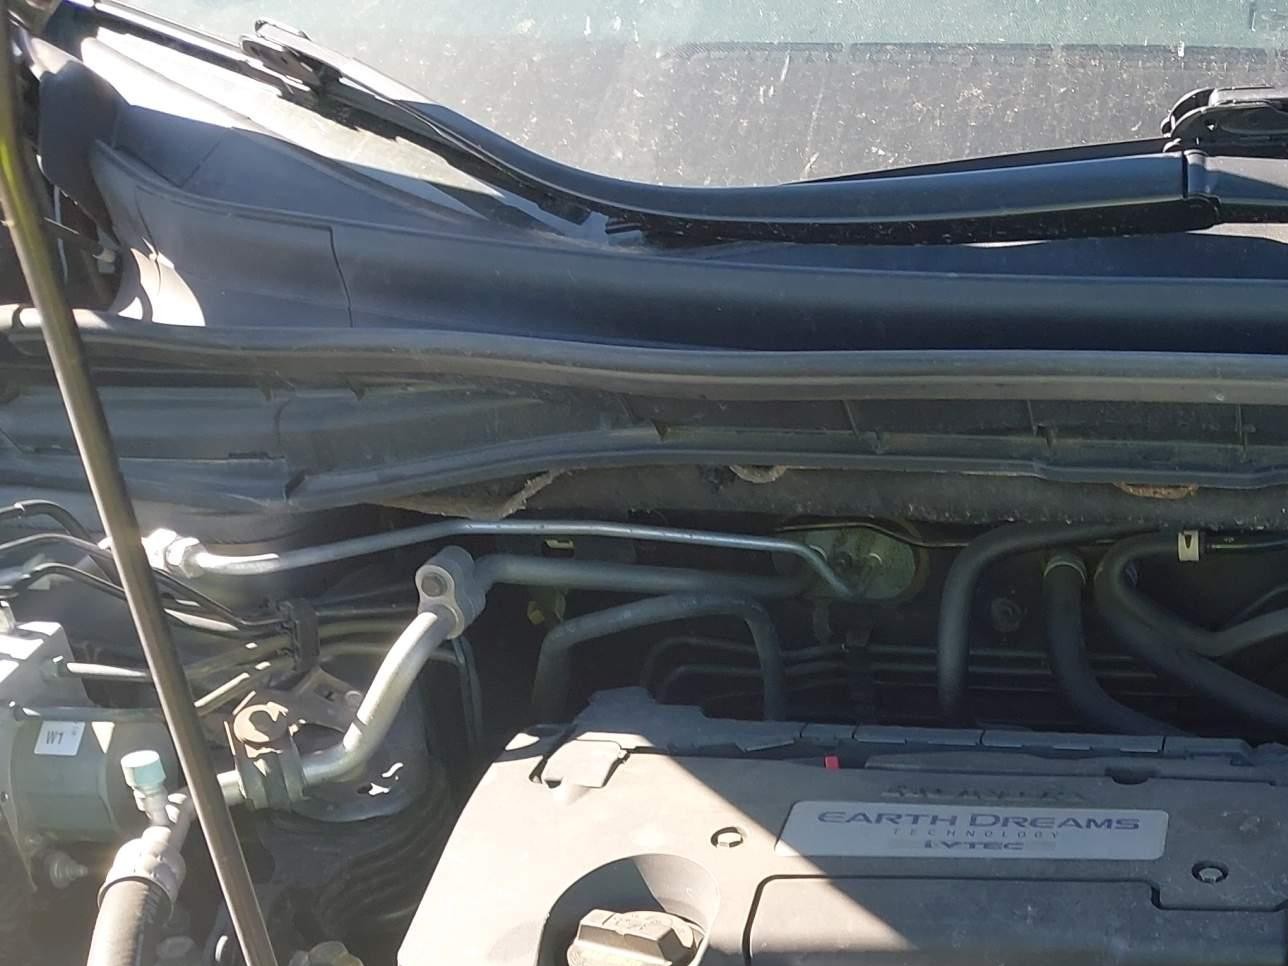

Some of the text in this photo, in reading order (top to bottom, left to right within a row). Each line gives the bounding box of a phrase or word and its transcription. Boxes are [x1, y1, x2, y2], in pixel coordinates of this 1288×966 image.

[817, 811, 1140, 831] EARTH DREAMS
[893, 827, 1058, 839] TECHNOLOGY
